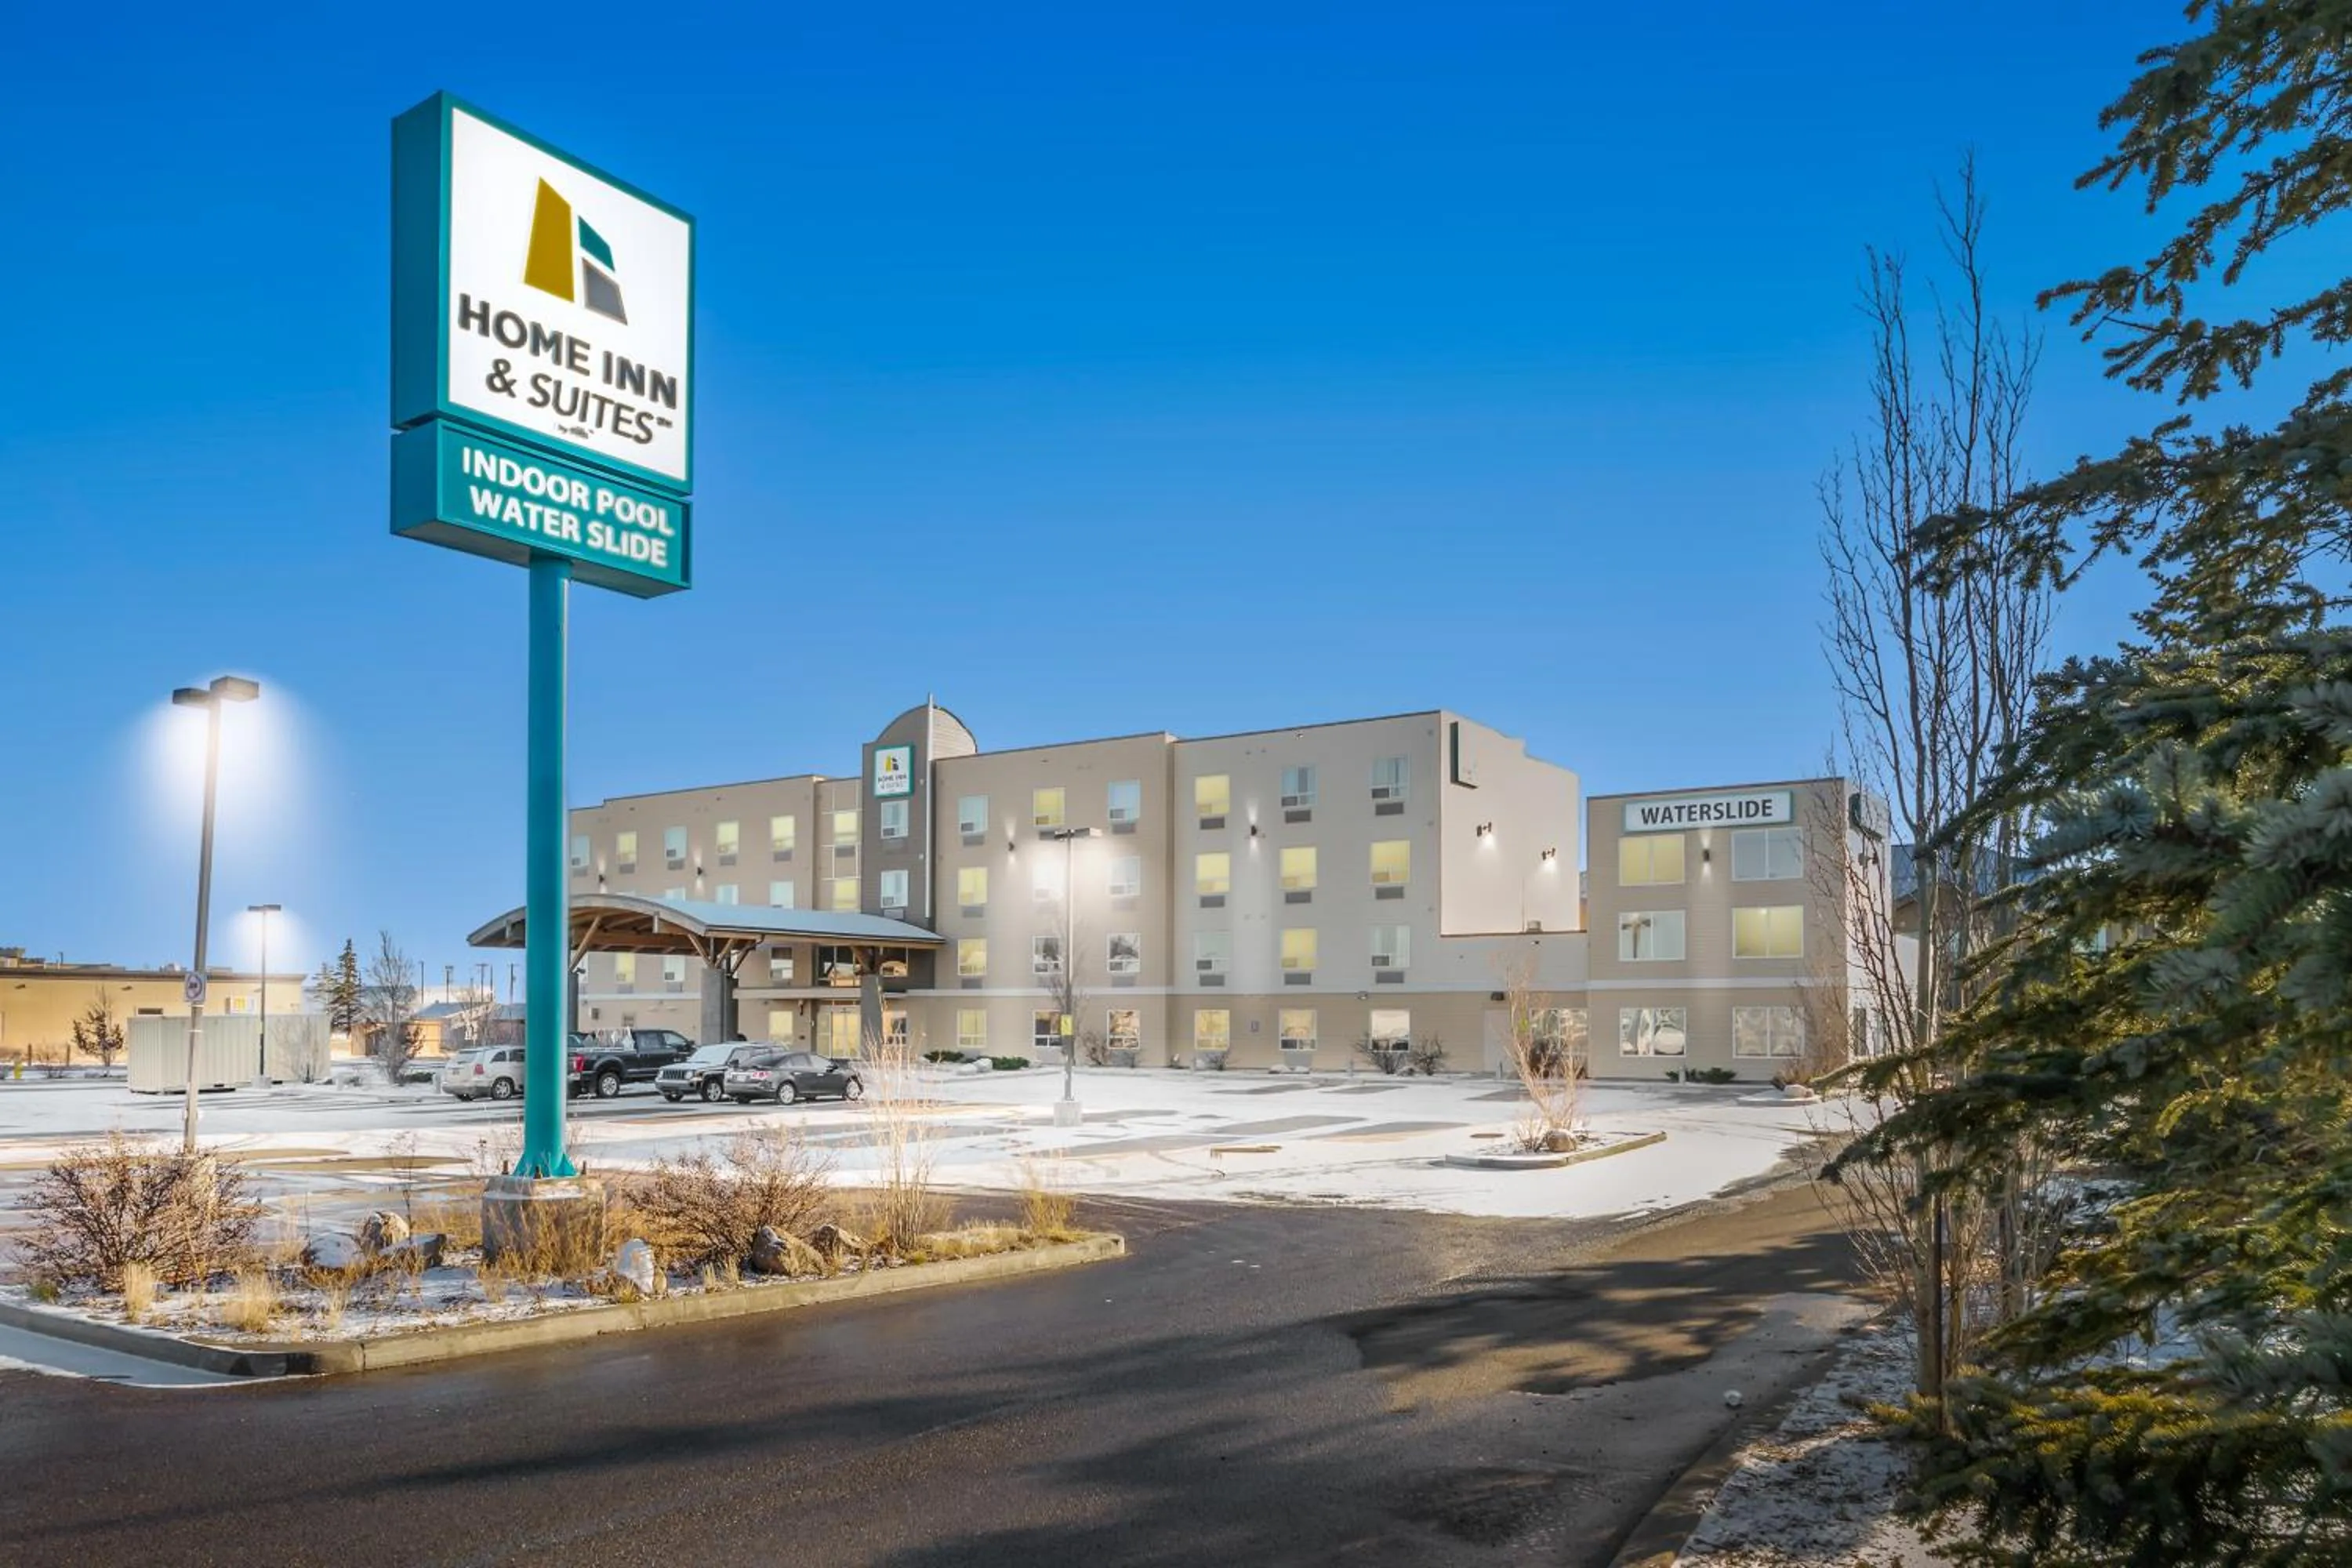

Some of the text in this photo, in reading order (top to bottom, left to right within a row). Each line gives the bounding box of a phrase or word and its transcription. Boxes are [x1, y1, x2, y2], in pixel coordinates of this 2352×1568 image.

[457, 292, 678, 410] HOME INN
[486, 358, 517, 398] &
[461, 446, 676, 536] INDOOR POOL
[470, 485, 669, 568] WATER SLIDE
[1641, 799, 1773, 825] WATERSLIDE
